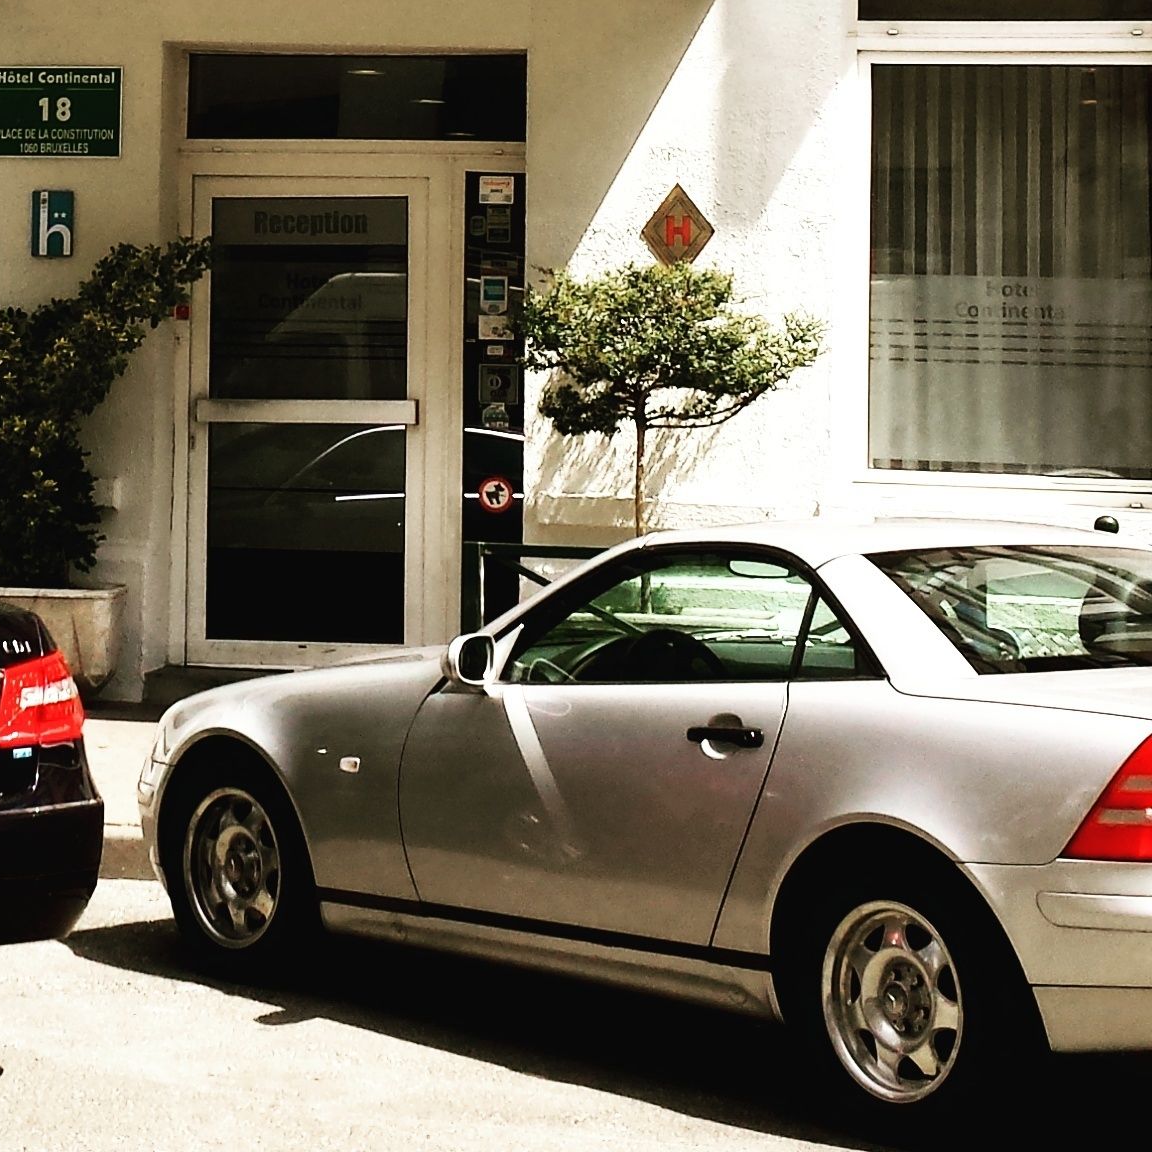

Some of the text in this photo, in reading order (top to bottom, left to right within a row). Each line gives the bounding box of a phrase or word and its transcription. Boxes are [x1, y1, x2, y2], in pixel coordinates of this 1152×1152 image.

[38, 71, 115, 84] Continental
[38, 97, 71, 122] 18
[25, 128, 36, 140] DE
[38, 128, 49, 140] LA
[50, 128, 114, 140] CONSTITUTION
[20, 142, 89, 154] 1060 BRUXELLES
[254, 210, 368, 236] Reception
[665, 214, 691, 247] H
[286, 272, 335, 289] Hot
[985, 280, 1042, 298] Hote
[955, 300, 1067, 320] Coninenta
